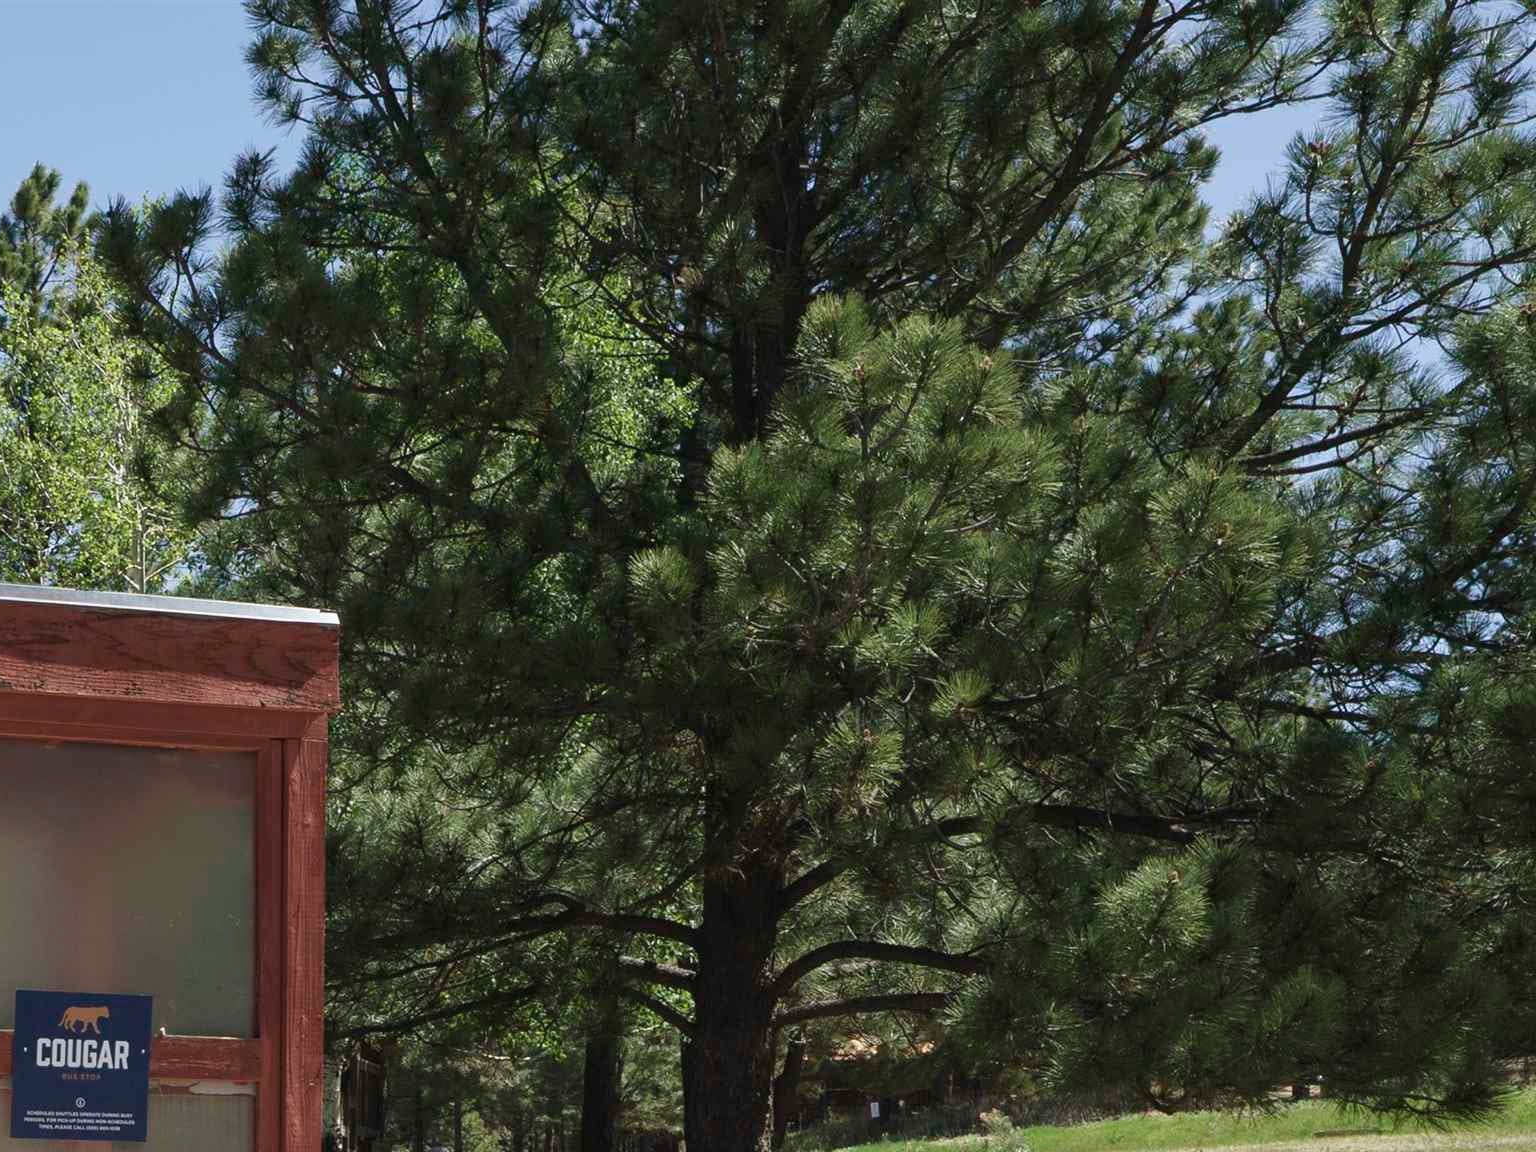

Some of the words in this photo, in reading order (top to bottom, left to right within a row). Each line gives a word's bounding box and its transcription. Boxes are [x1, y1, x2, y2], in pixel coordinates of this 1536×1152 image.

[36, 1037, 130, 1070] COUGAR
[62, 1073, 78, 1081] BUS
[80, 1073, 101, 1081] STOP
